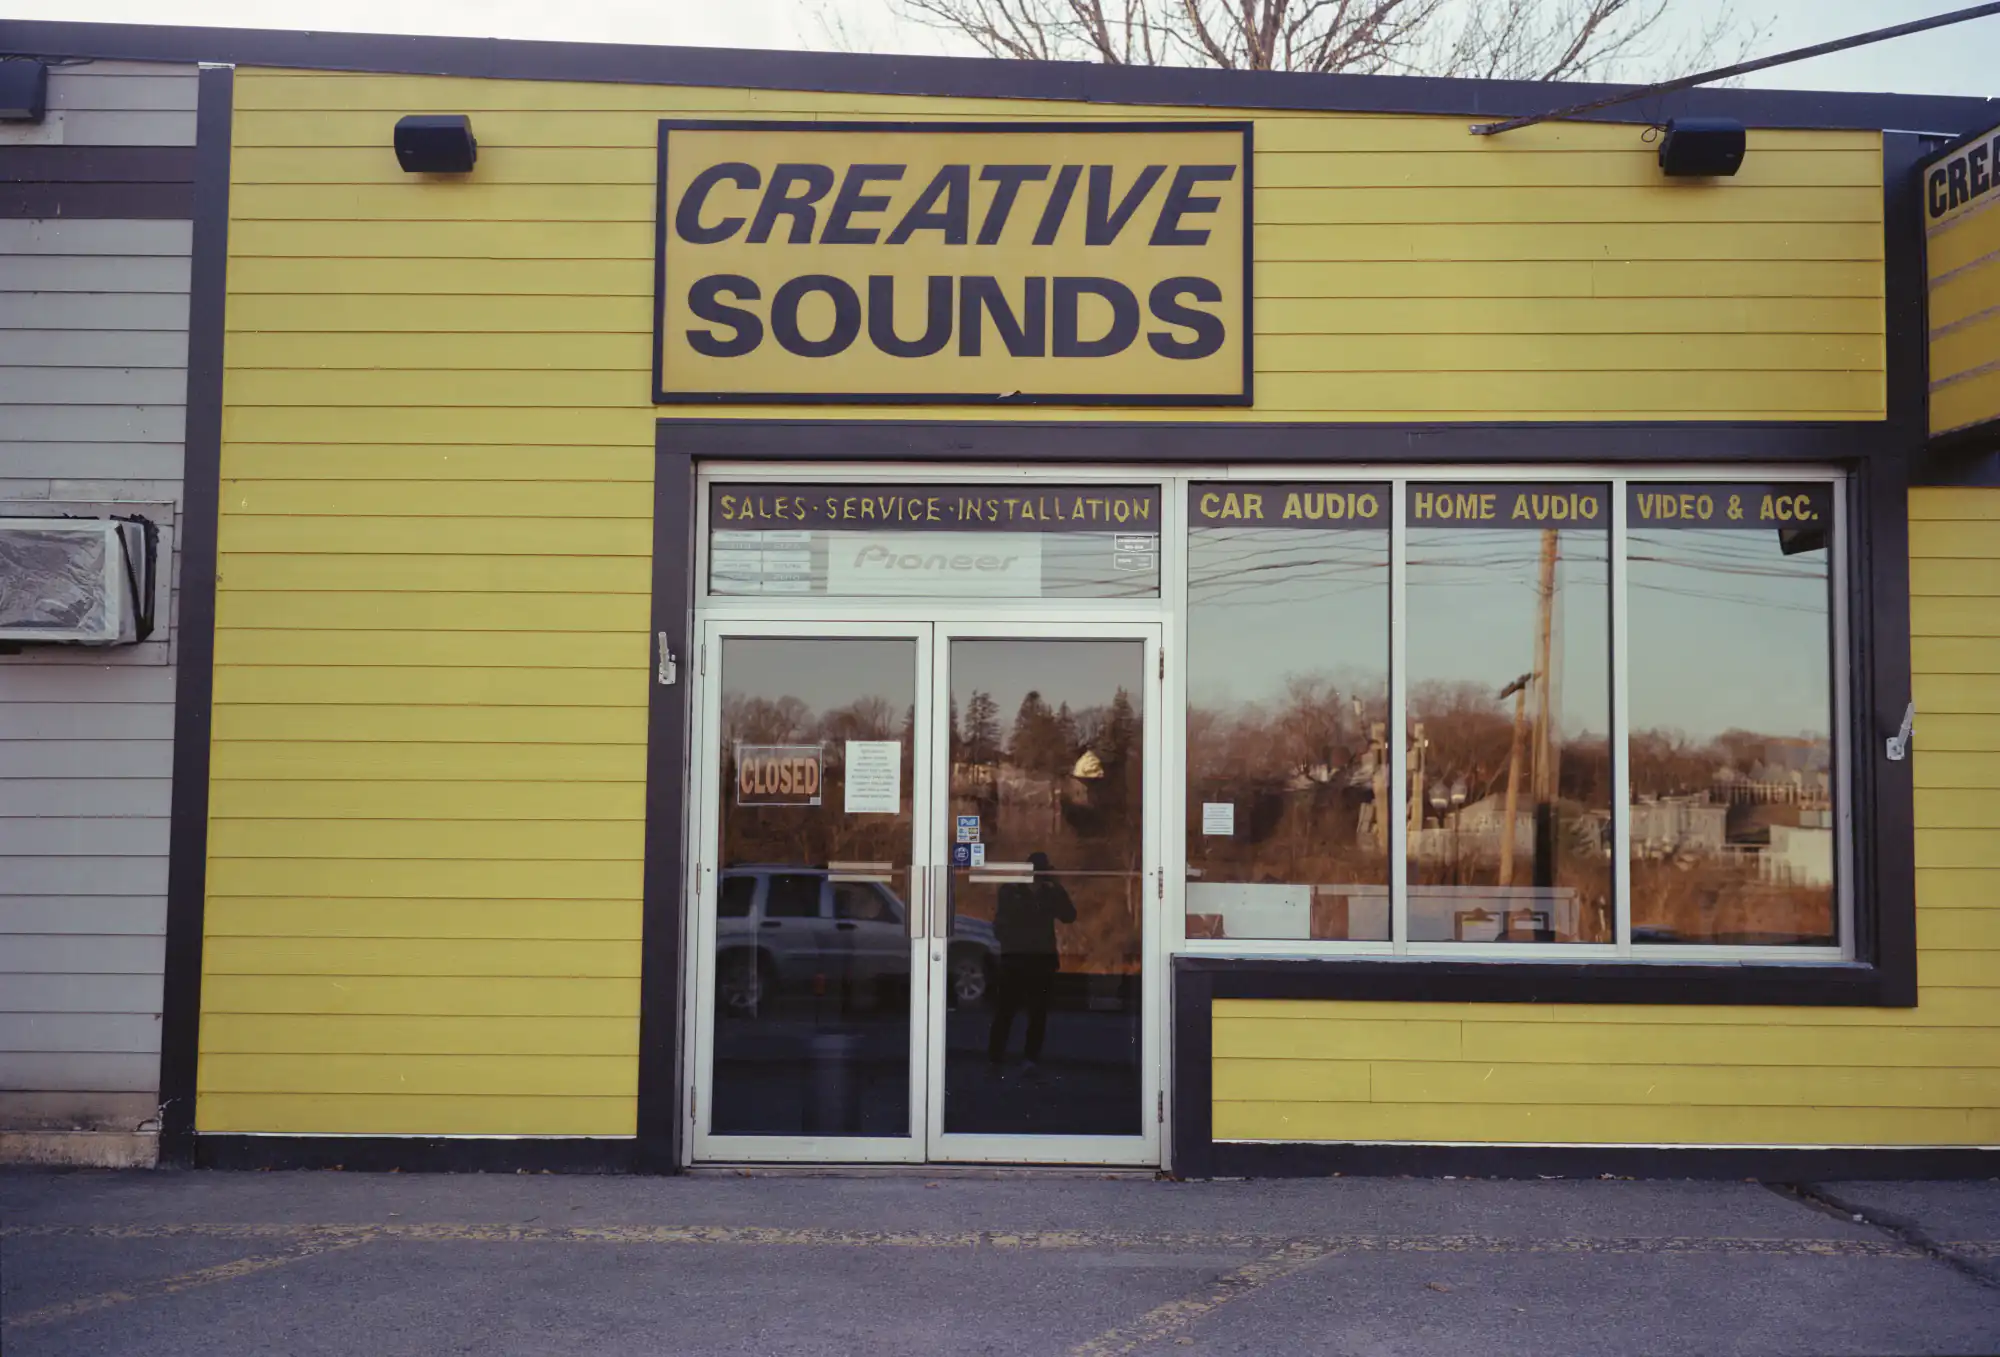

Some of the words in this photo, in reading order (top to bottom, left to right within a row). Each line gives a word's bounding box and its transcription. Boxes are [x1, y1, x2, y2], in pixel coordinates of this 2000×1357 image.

[675, 162, 1237, 246] CREATIVE
[685, 273, 1226, 360] SOUNDS
[721, 495, 806, 521] SALES
[825, 496, 941, 522] SERVICE
[957, 497, 1151, 523] INSTALLATION
[1200, 491, 1265, 520] CAR
[1282, 492, 1379, 520] AUDIO
[1415, 491, 1497, 520] HOME
[1511, 493, 1599, 521] AUDIO
[1637, 493, 1713, 521] VIDEO
[1727, 494, 1744, 521] &
[1760, 494, 1819, 521] ACC.
[853, 544, 1019, 572] Pioneer
[741, 757, 819, 794] CLOSED
